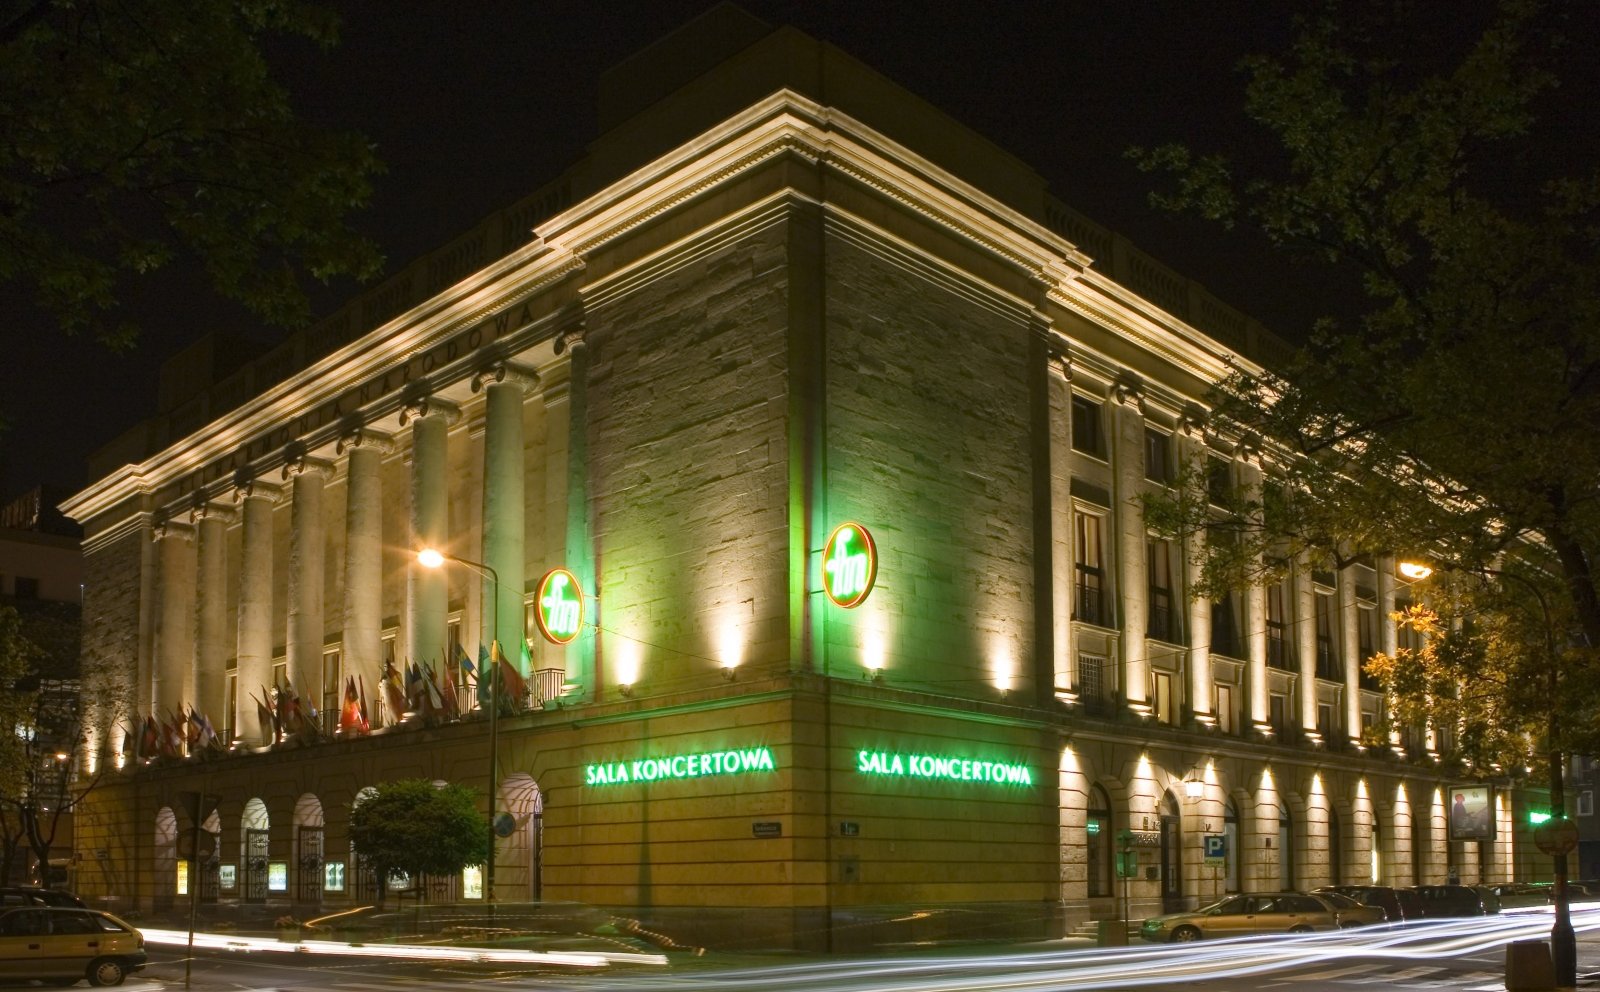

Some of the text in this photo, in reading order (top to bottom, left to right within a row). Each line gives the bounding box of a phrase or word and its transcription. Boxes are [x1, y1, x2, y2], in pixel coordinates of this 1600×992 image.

[179, 303, 534, 497] FILHARMONIA NARODOWA
[587, 748, 774, 785] SALA KONCERTOWA
[859, 750, 1031, 785] SALA KONCERTOWA
[1208, 838, 1221, 855] P
